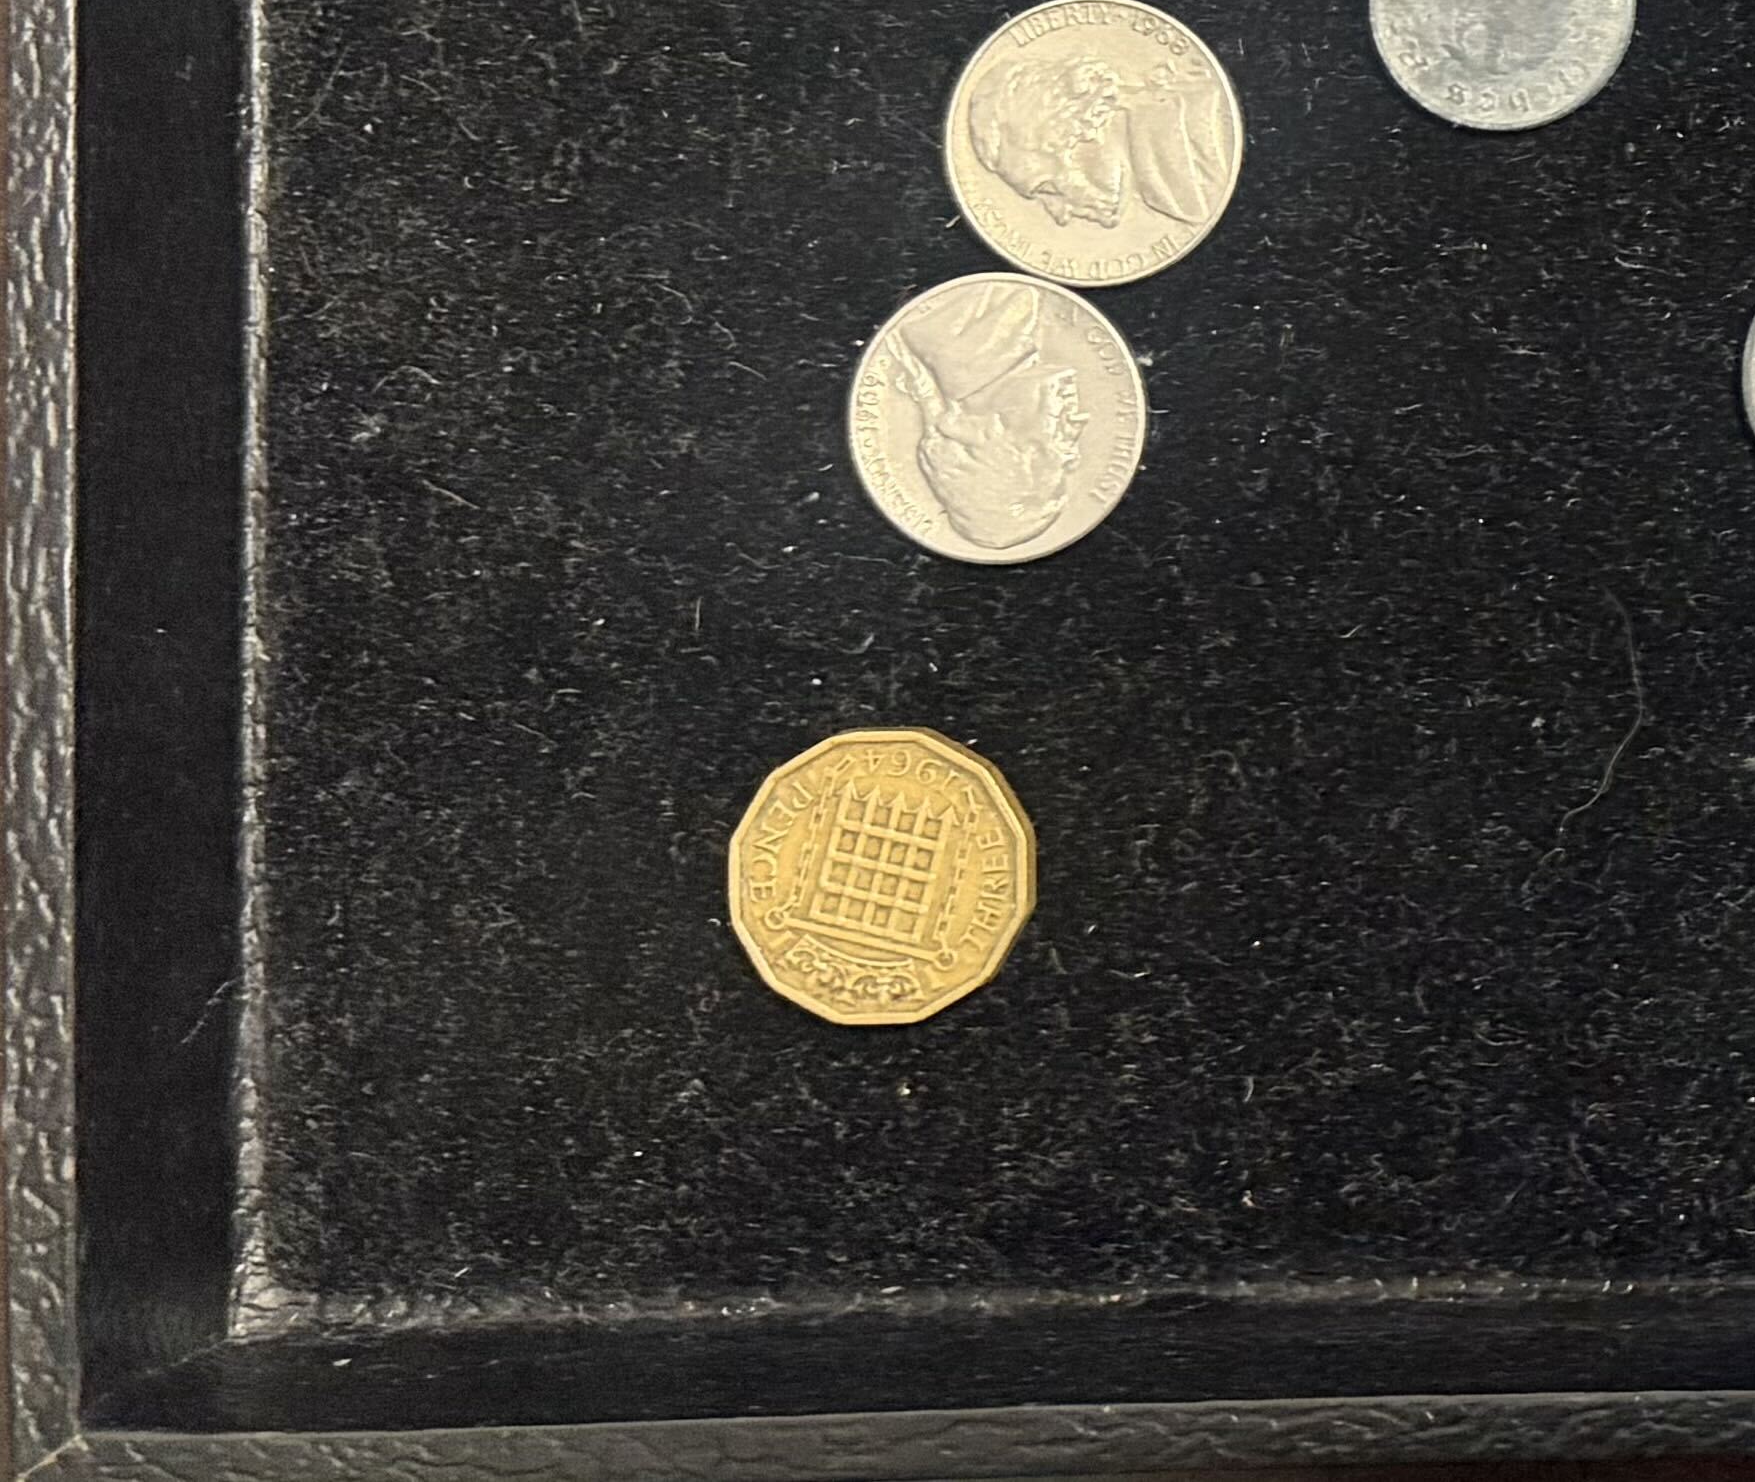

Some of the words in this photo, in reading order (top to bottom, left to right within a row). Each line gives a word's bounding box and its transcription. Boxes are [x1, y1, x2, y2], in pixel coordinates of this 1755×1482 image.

[1008, 2, 1118, 49] LIBERTY
[864, 747, 962, 790] 1964
[750, 779, 816, 905] PENCE
[960, 821, 1011, 956] THREE
